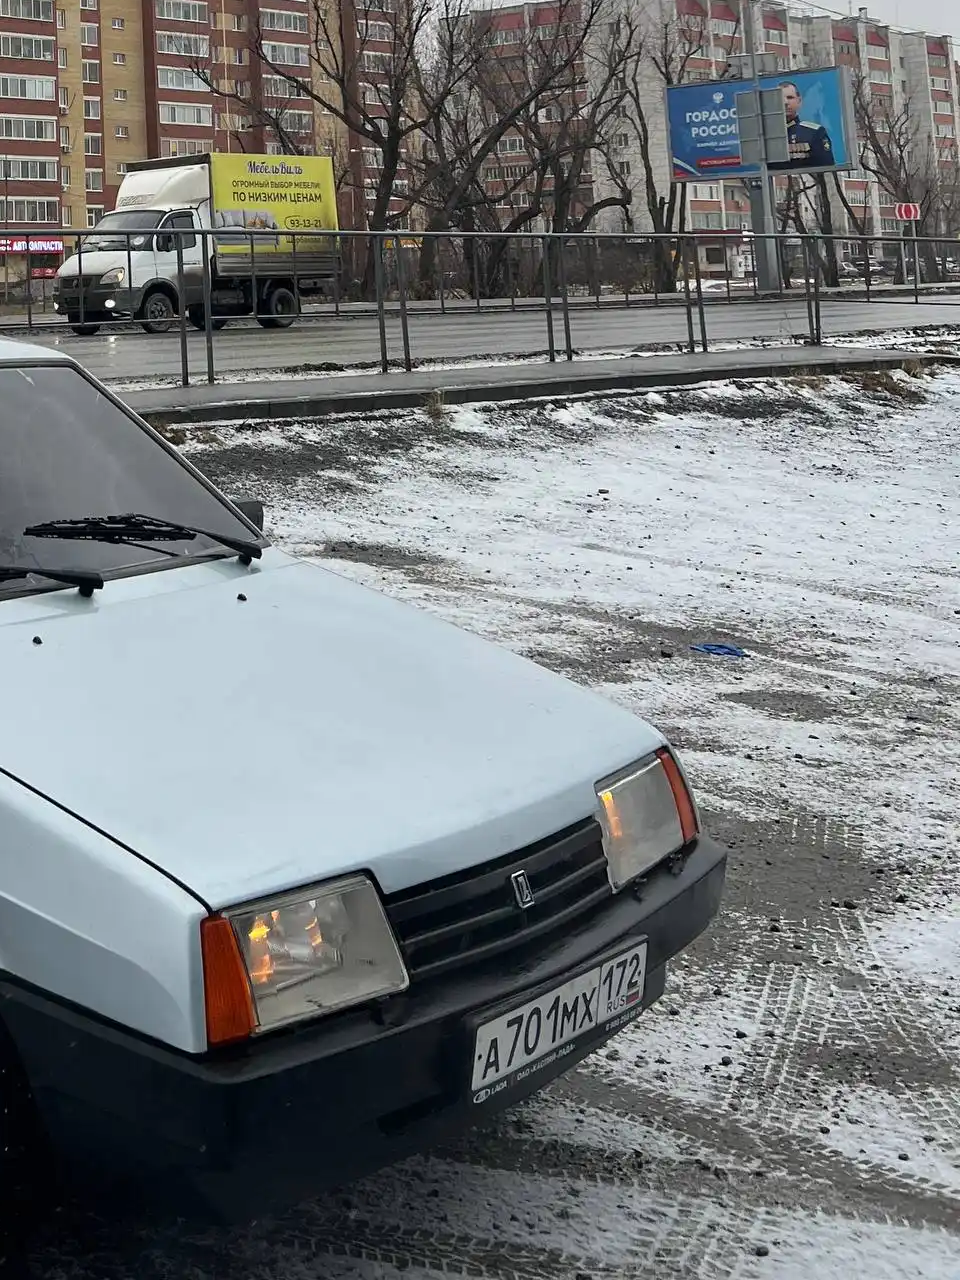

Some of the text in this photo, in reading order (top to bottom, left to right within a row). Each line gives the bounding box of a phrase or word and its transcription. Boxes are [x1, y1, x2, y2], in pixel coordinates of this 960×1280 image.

[232, 180, 269, 189] ОГРОМНЫЙ
[271, 181, 293, 189] ВЫБОР
[232, 191, 322, 204] ПО НИЗКИМ ЦЕНАМ
[290, 219, 322, 228] 93-13-21
[606, 994, 626, 1014] RUS
[482, 953, 640, 1080] А701МХ 172
[491, 1080, 507, 1095] LADA
